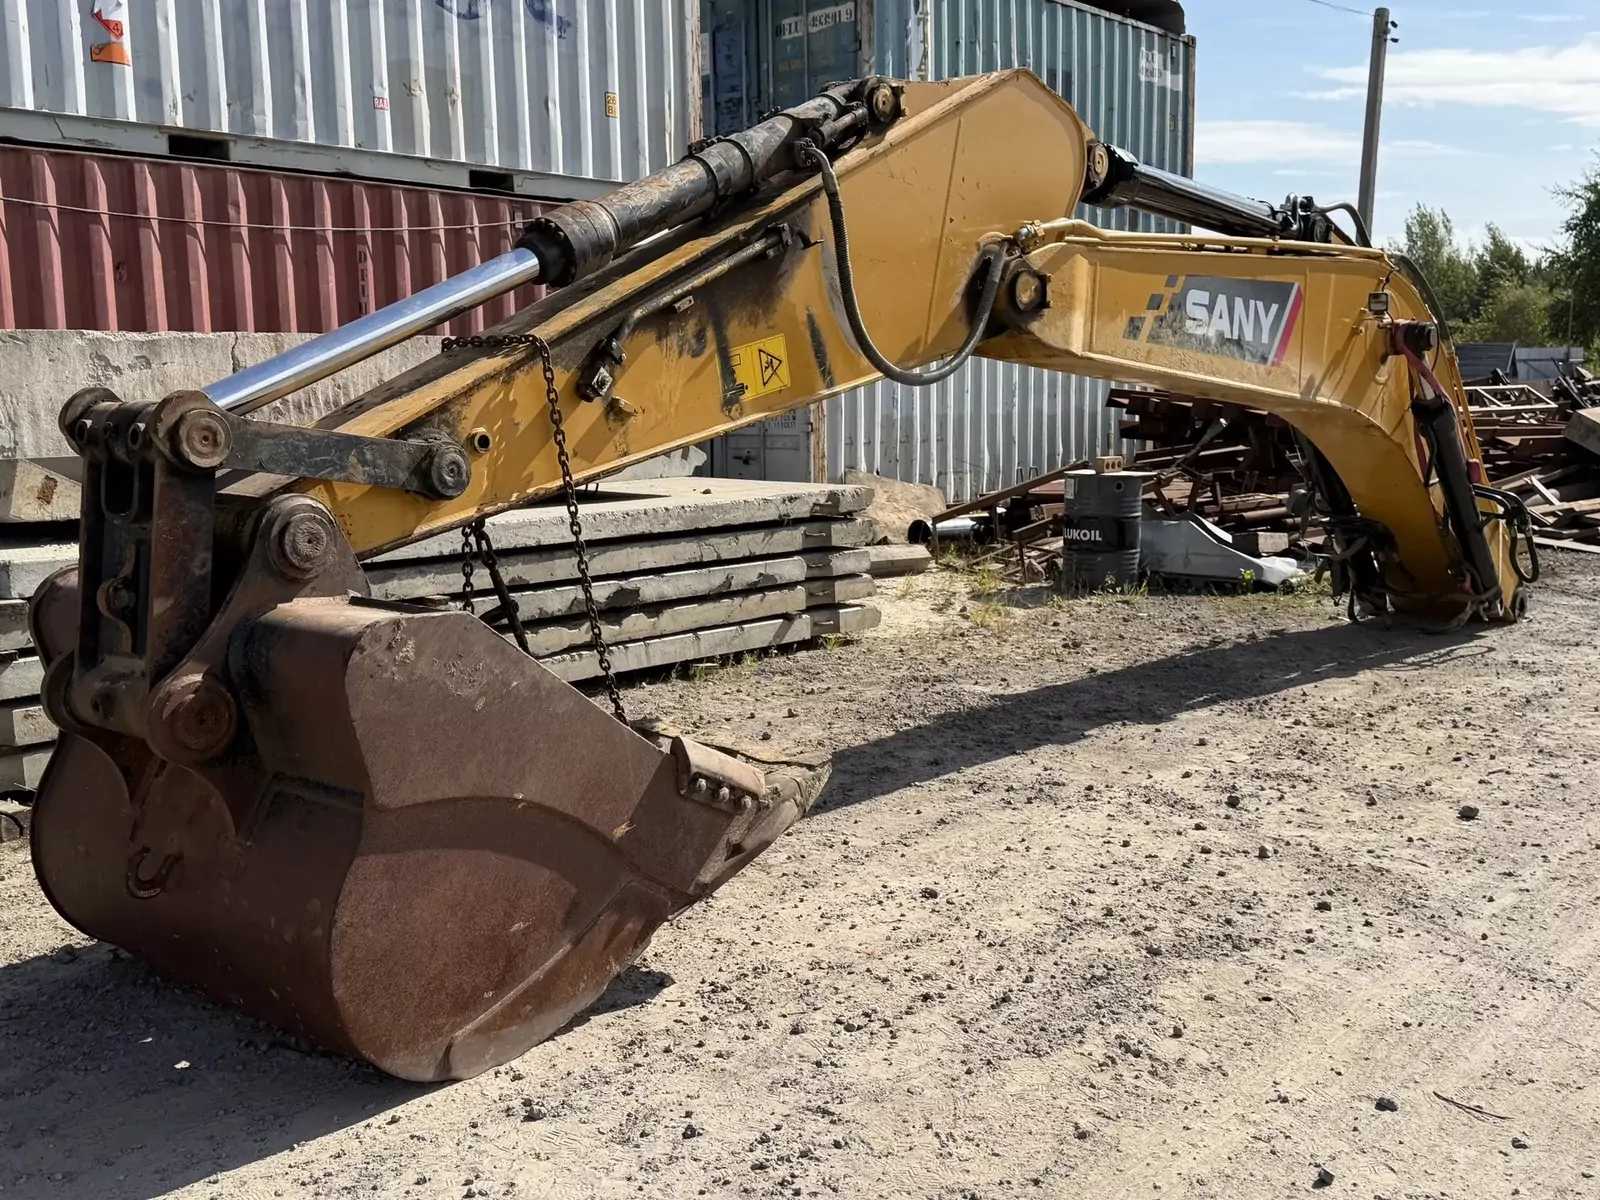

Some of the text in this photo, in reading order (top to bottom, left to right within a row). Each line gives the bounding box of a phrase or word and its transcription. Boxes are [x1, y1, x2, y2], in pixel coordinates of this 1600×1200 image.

[845, 7, 853, 21] 9
[112, 22, 120, 33] 4
[1185, 289, 1279, 344] SANY
[1063, 528, 1102, 541] LUKOIL
